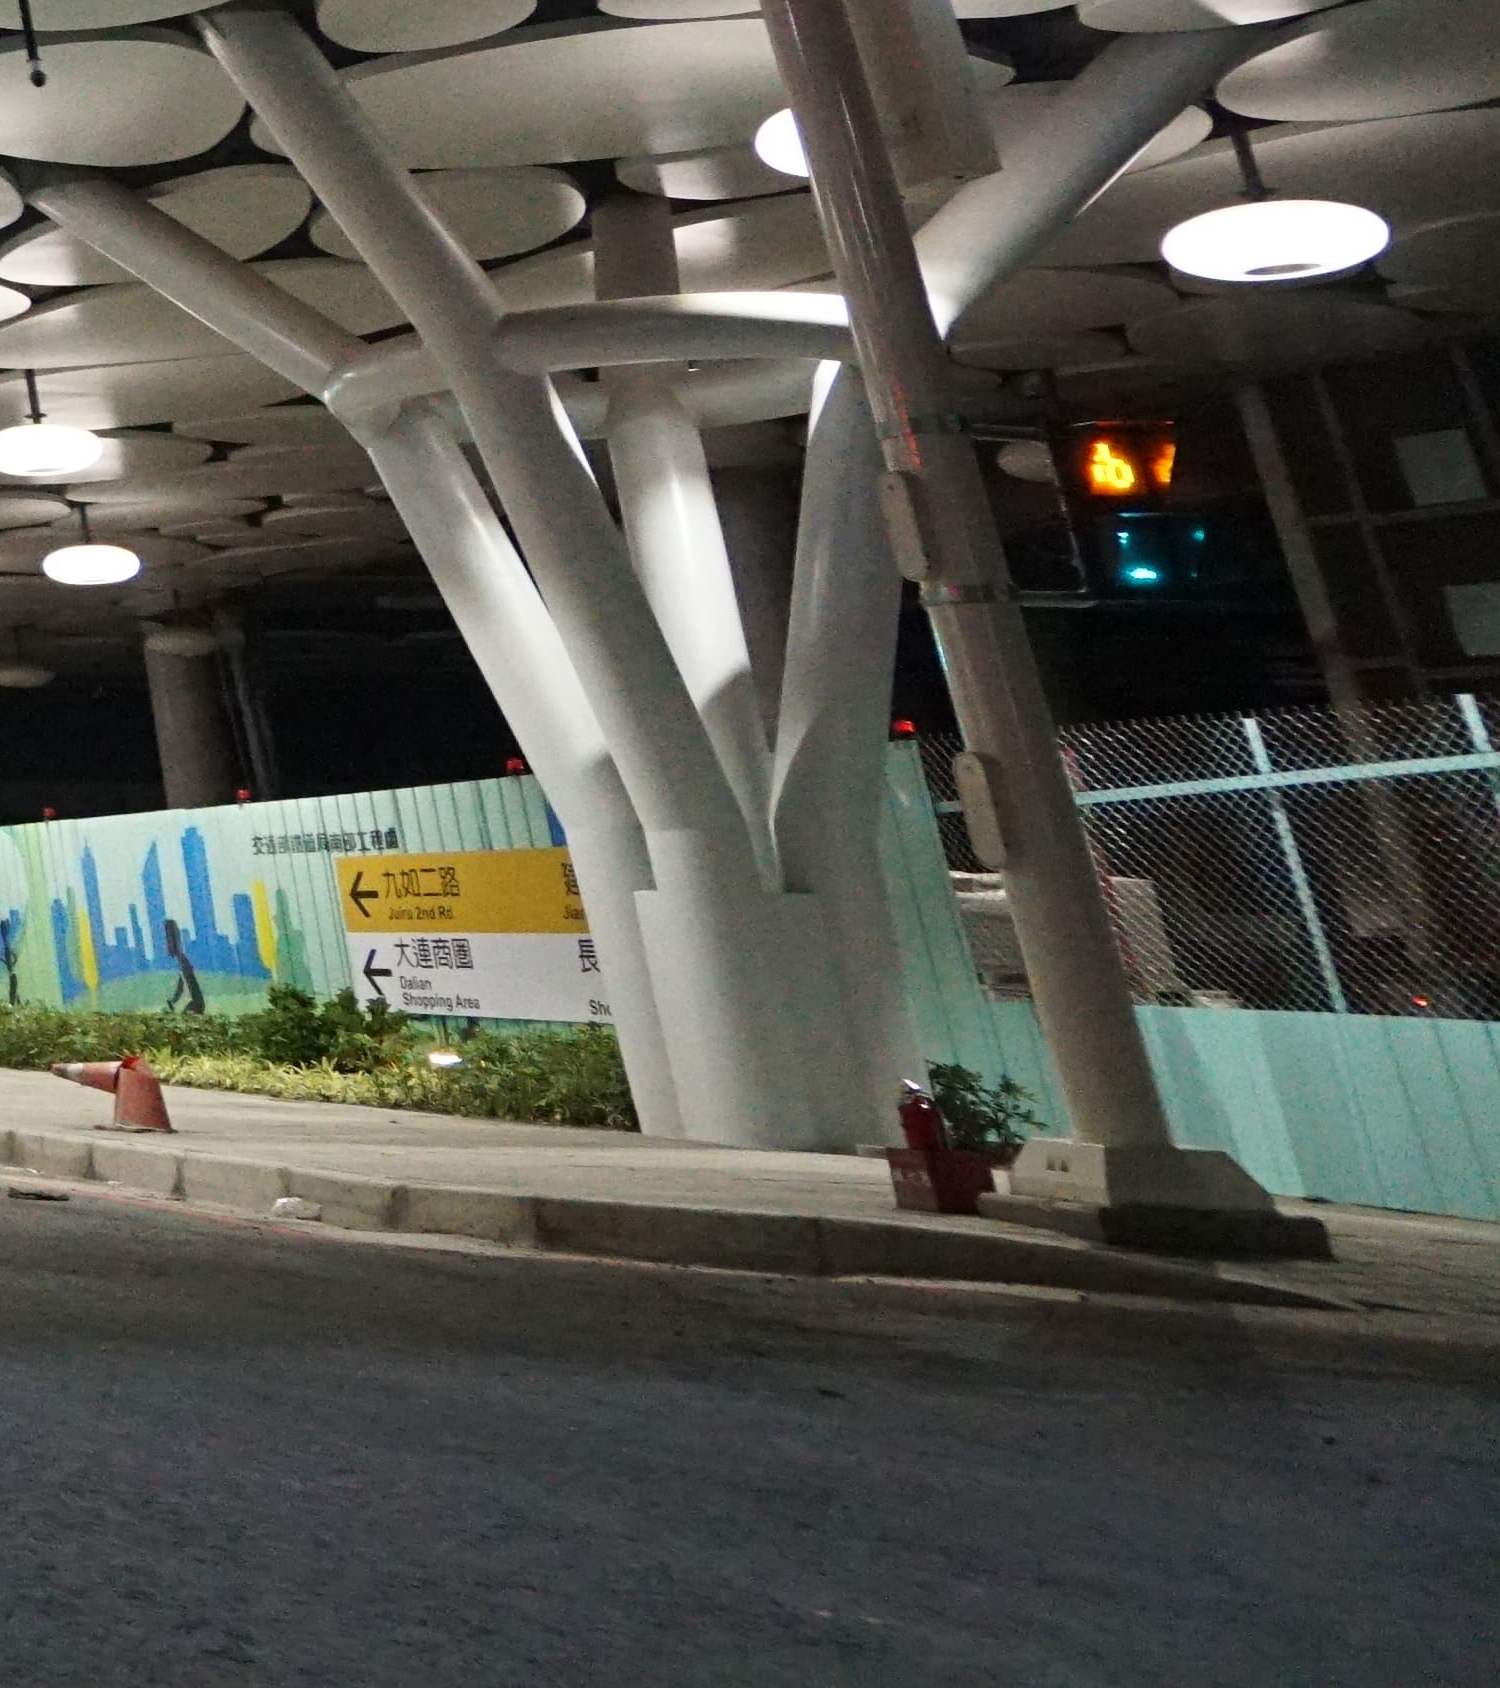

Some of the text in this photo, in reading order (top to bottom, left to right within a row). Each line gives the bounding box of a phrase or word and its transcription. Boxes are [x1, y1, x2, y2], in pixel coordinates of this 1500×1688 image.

[382, 866, 461, 899] 九如二路
[415, 905, 436, 920] 2nd
[394, 937, 474, 970] 大連商圈
[399, 975, 433, 991] Dalian
[402, 992, 482, 1012] Shopping Area
